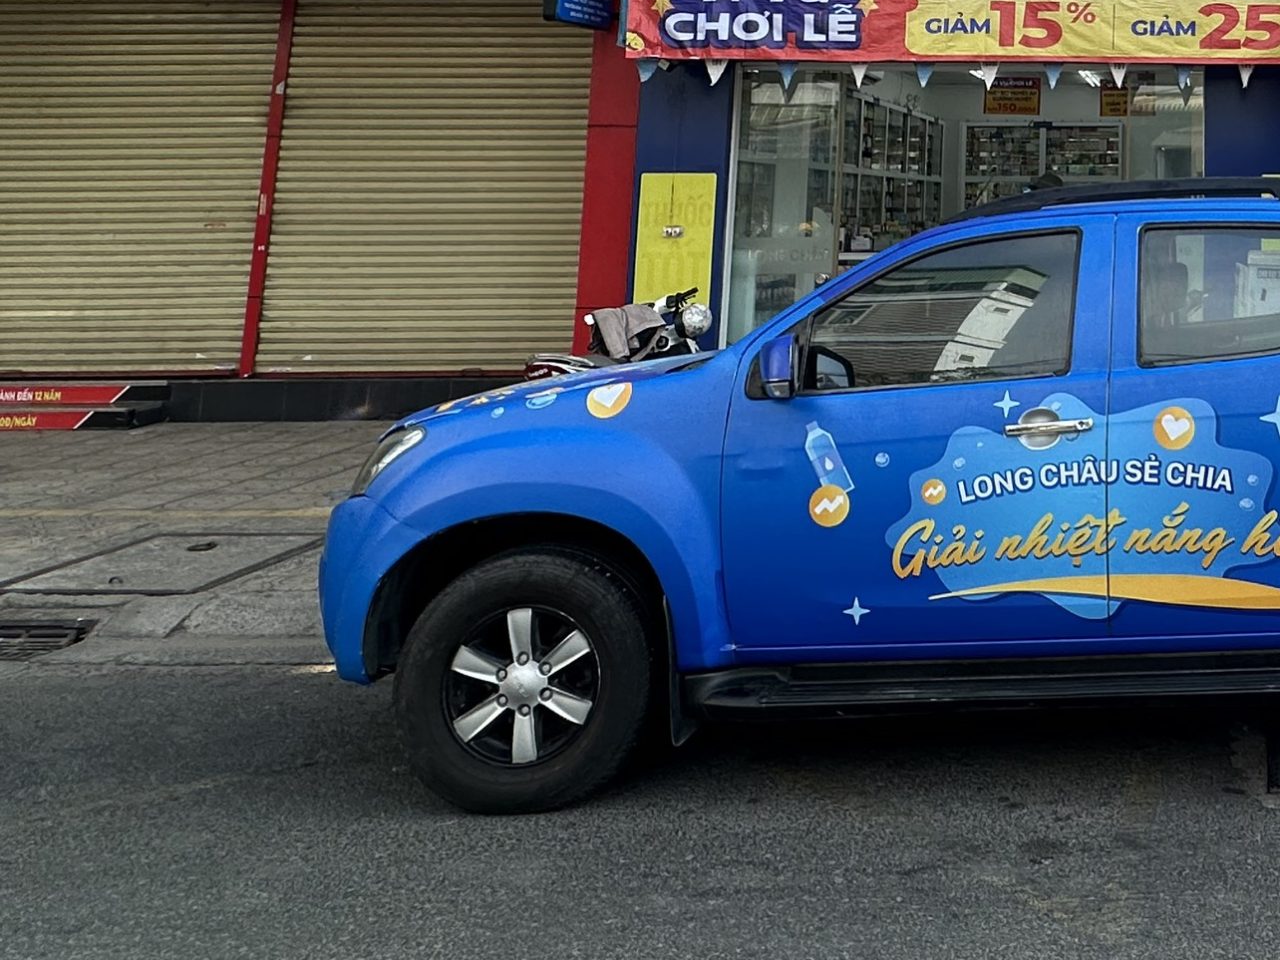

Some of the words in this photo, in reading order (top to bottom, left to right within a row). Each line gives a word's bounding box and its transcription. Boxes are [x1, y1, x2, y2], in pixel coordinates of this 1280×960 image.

[664, 9, 784, 42] CHƠI
[803, 2, 858, 42] LỄ
[924, 12, 991, 35] GIẢM
[990, 0, 1097, 49] 15%
[1130, 14, 1197, 38] GIẢM
[957, 470, 1034, 505] LONG
[1040, 454, 1118, 487] CHÂU
[1123, 453, 1160, 486] SẺ
[1165, 461, 1234, 493] CHIA
[891, 519, 985, 578] Giải
[996, 507, 1126, 567] nhiệt
[1124, 500, 1235, 570] nắng
